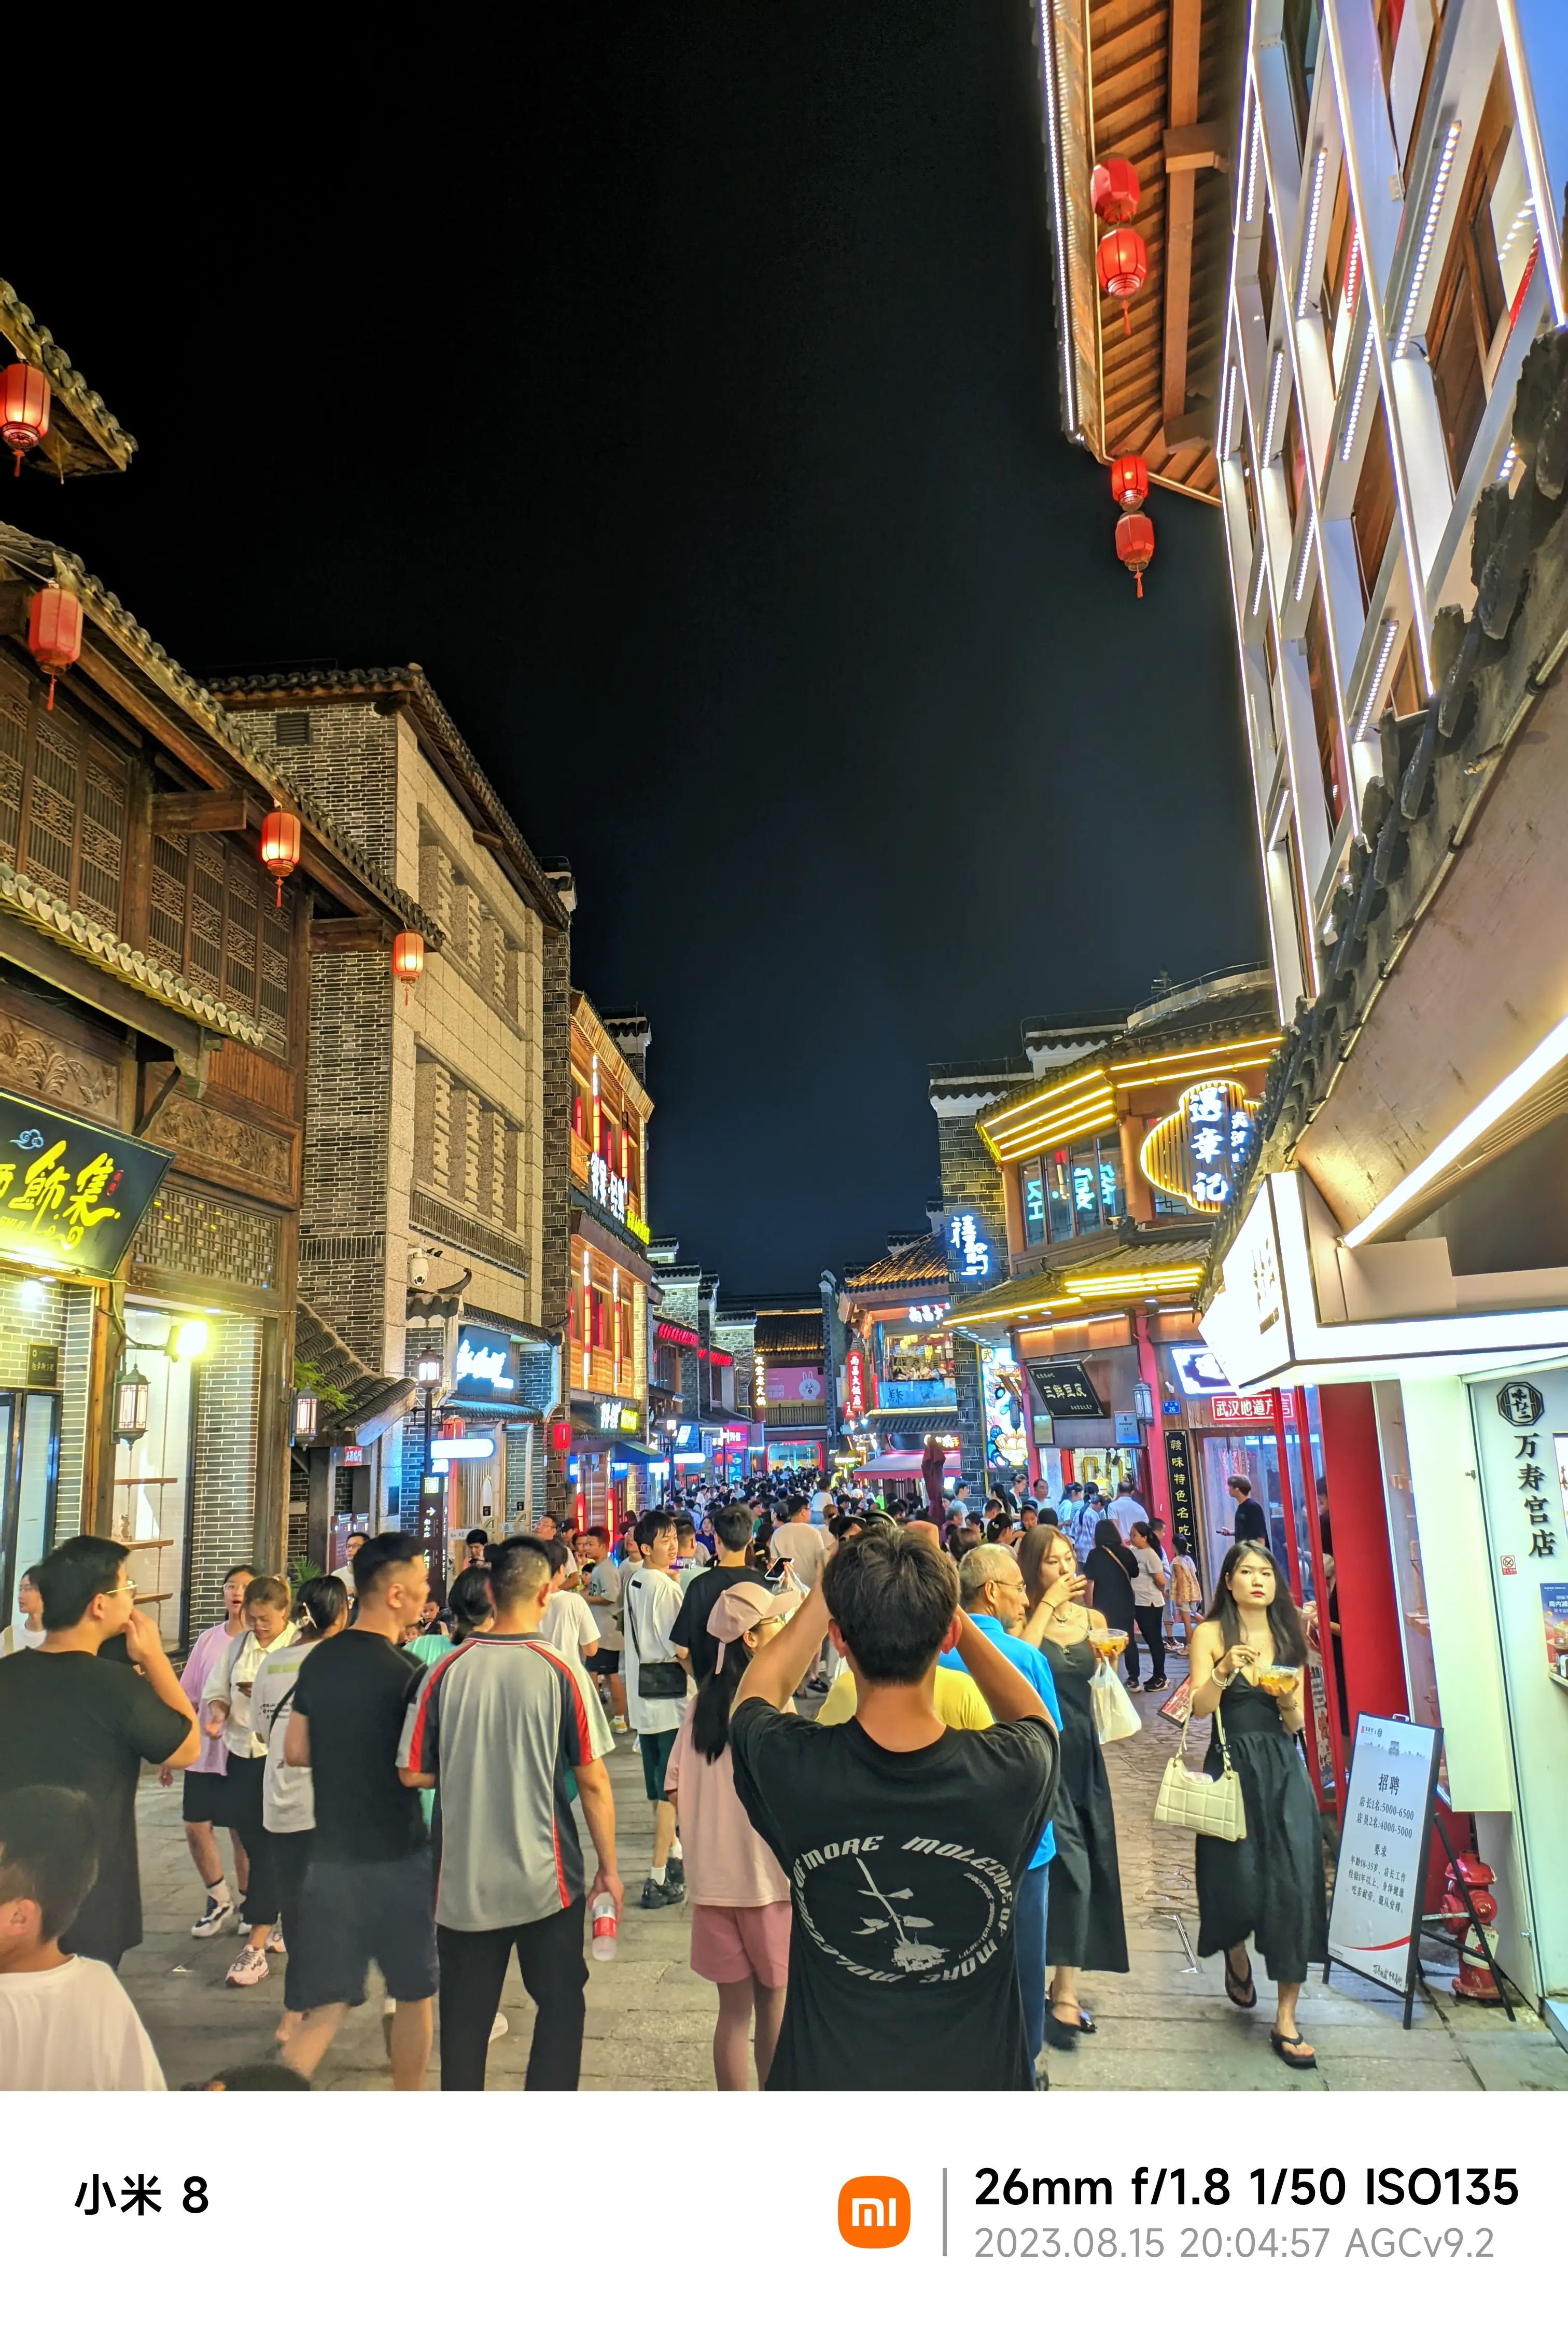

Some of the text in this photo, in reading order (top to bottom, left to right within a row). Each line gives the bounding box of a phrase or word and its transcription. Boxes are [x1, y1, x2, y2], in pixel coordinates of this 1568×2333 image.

[909, 1302, 950, 1323] 南昌大
[850, 1355, 861, 1406] 南昌大饭店
[1043, 1383, 1087, 1398] 三鲜豆皮
[1514, 1433, 1556, 1558] 万寿宫店
[1378, 1773, 1400, 1796] 招聘
[801, 1836, 885, 1870] MORE
[1374, 1843, 1387, 1857] 要求
[901, 1837, 1013, 1904] MOLECULE
[919, 1939, 998, 1983] MORE
